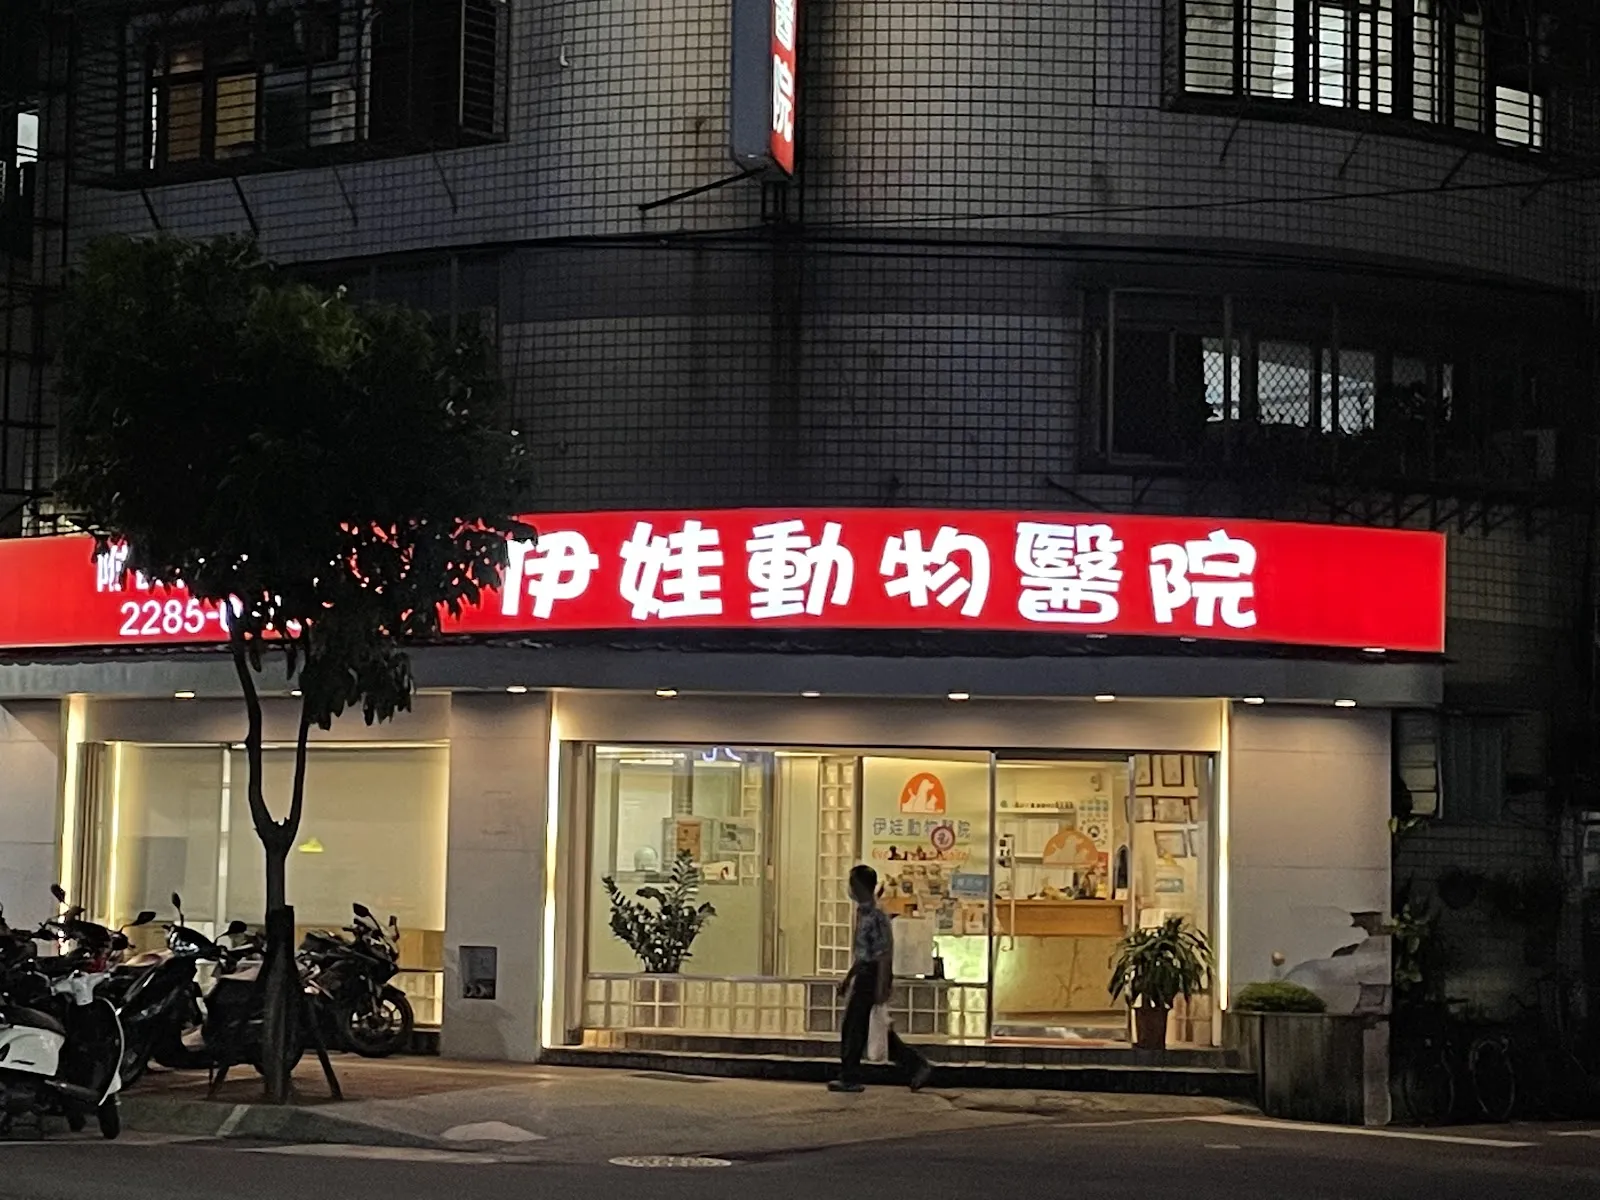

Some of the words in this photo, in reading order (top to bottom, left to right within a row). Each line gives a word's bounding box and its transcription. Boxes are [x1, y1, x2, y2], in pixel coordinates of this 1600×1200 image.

[501, 519, 1257, 627] 伊娃動物醫院
